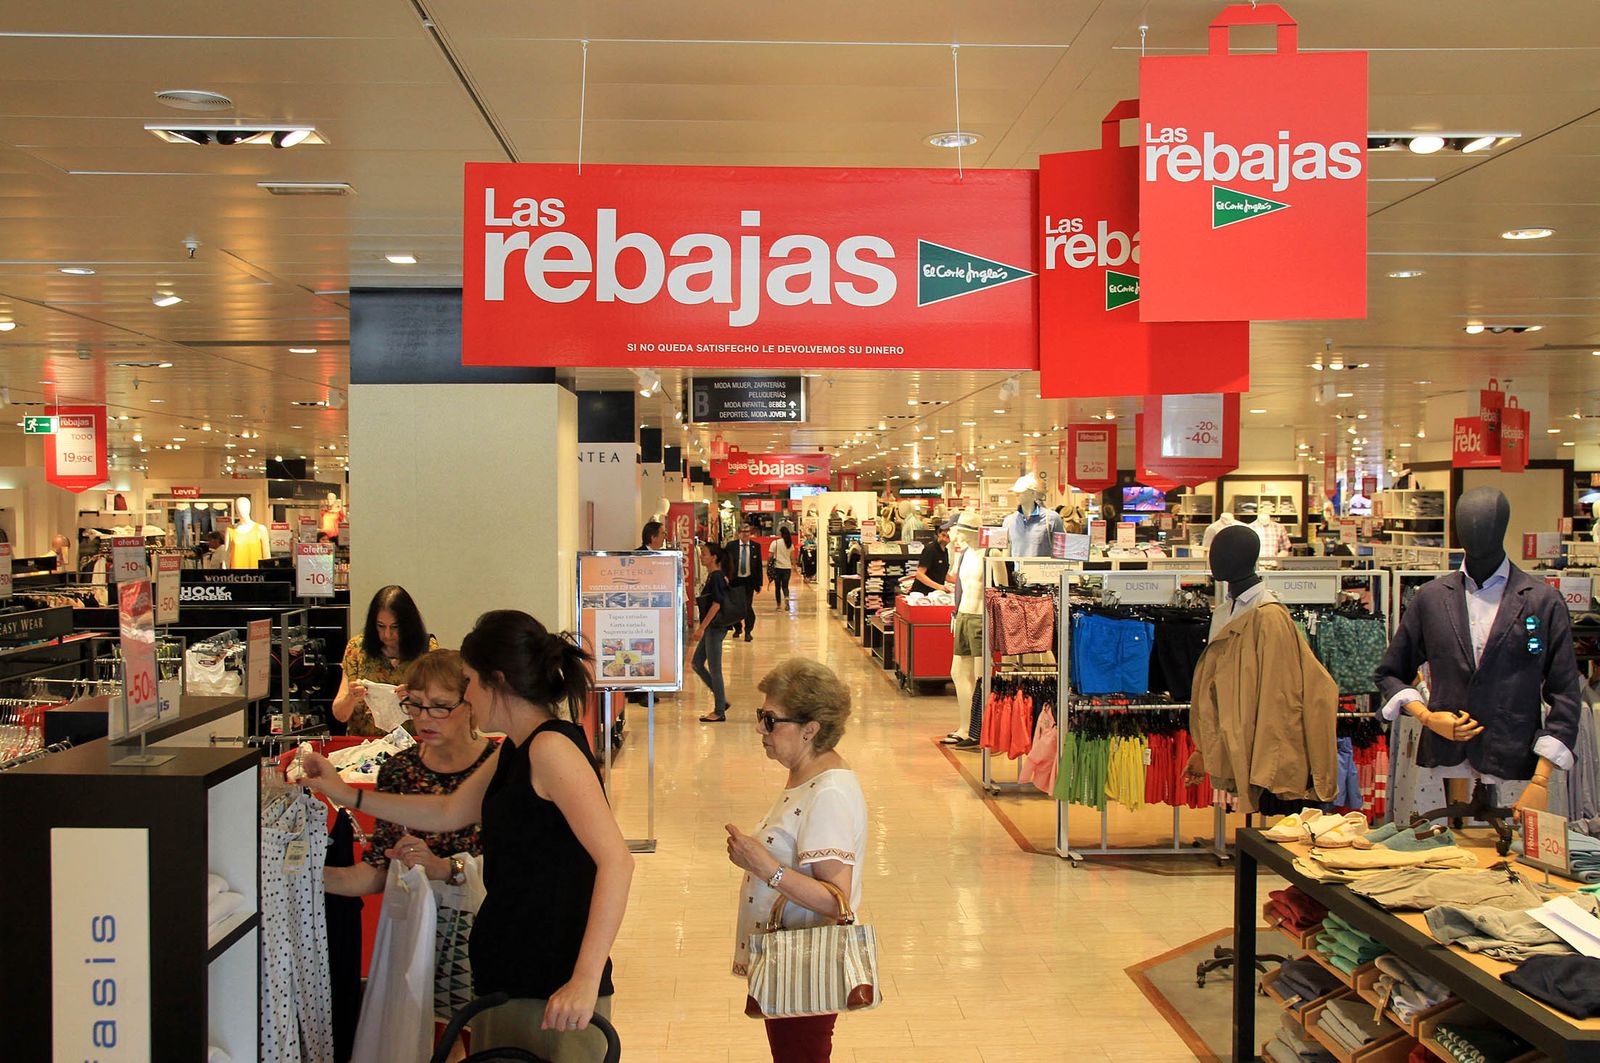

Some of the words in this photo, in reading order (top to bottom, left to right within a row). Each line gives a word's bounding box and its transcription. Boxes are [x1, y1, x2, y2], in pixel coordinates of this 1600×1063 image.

[1146, 123, 1188, 143] Las
[1146, 131, 1362, 192] rebajas
[484, 188, 566, 227] Las
[1216, 201, 1225, 210] El
[1225, 201, 1244, 210] Corte
[1244, 200, 1272, 213] Inglés
[1045, 216, 1084, 234] Las
[1045, 221, 1140, 269] reb
[484, 208, 898, 327] rebajas
[923, 263, 936, 278] El
[936, 265, 965, 278] Corte
[965, 262, 1008, 283] Inglés
[627, 343, 637, 352] SI
[640, 343, 655, 352] NO
[658, 343, 693, 353] QUEDA
[696, 344, 759, 353] SATISFECHO
[762, 344, 775, 353] LE
[778, 345, 846, 353] DEVOLVEMOS
[849, 345, 863, 354] SU
[865, 346, 904, 354] DINERO
[754, 381, 786, 389] ZAPATERÍAS
[695, 391, 709, 417] B
[769, 400, 787, 408] BEBÉS
[63, 452, 93, 463] 19,99€
[748, 460, 805, 478] ebajas
[302, 545, 329, 554] oferta
[204, 574, 265, 582] wonderbra
[1125, 582, 1159, 590] DUSTIN
[1284, 582, 1317, 590] DUSTIN
[20, 617, 44, 631] WEAR
[84, 914, 117, 1063] asis
